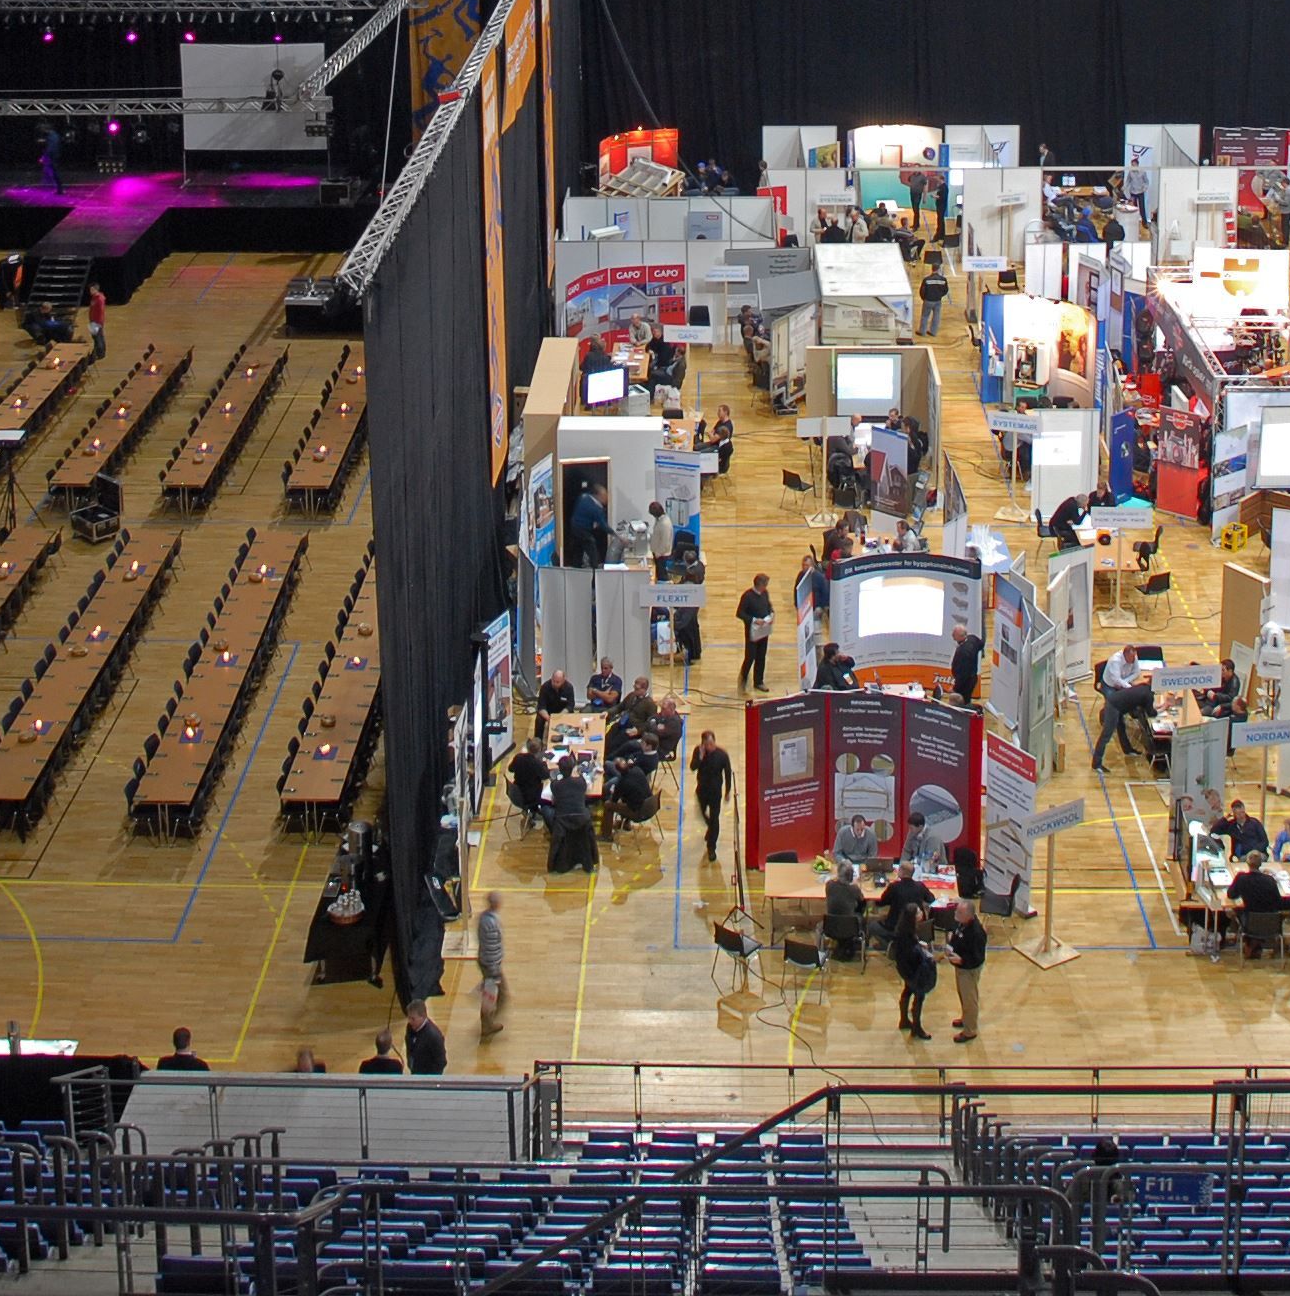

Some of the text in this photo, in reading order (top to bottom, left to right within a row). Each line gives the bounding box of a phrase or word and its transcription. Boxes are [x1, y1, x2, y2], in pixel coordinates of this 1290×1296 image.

[616, 270, 641, 280] GAPO
[654, 269, 679, 278] GAPO
[656, 594, 690, 603] FLEXIT
[1161, 676, 1214, 686] SWEDOOR
[1245, 731, 1290, 742] NORDAN
[1025, 811, 1081, 838] ROCKWOOL
[1145, 1177, 1174, 1192] F11
